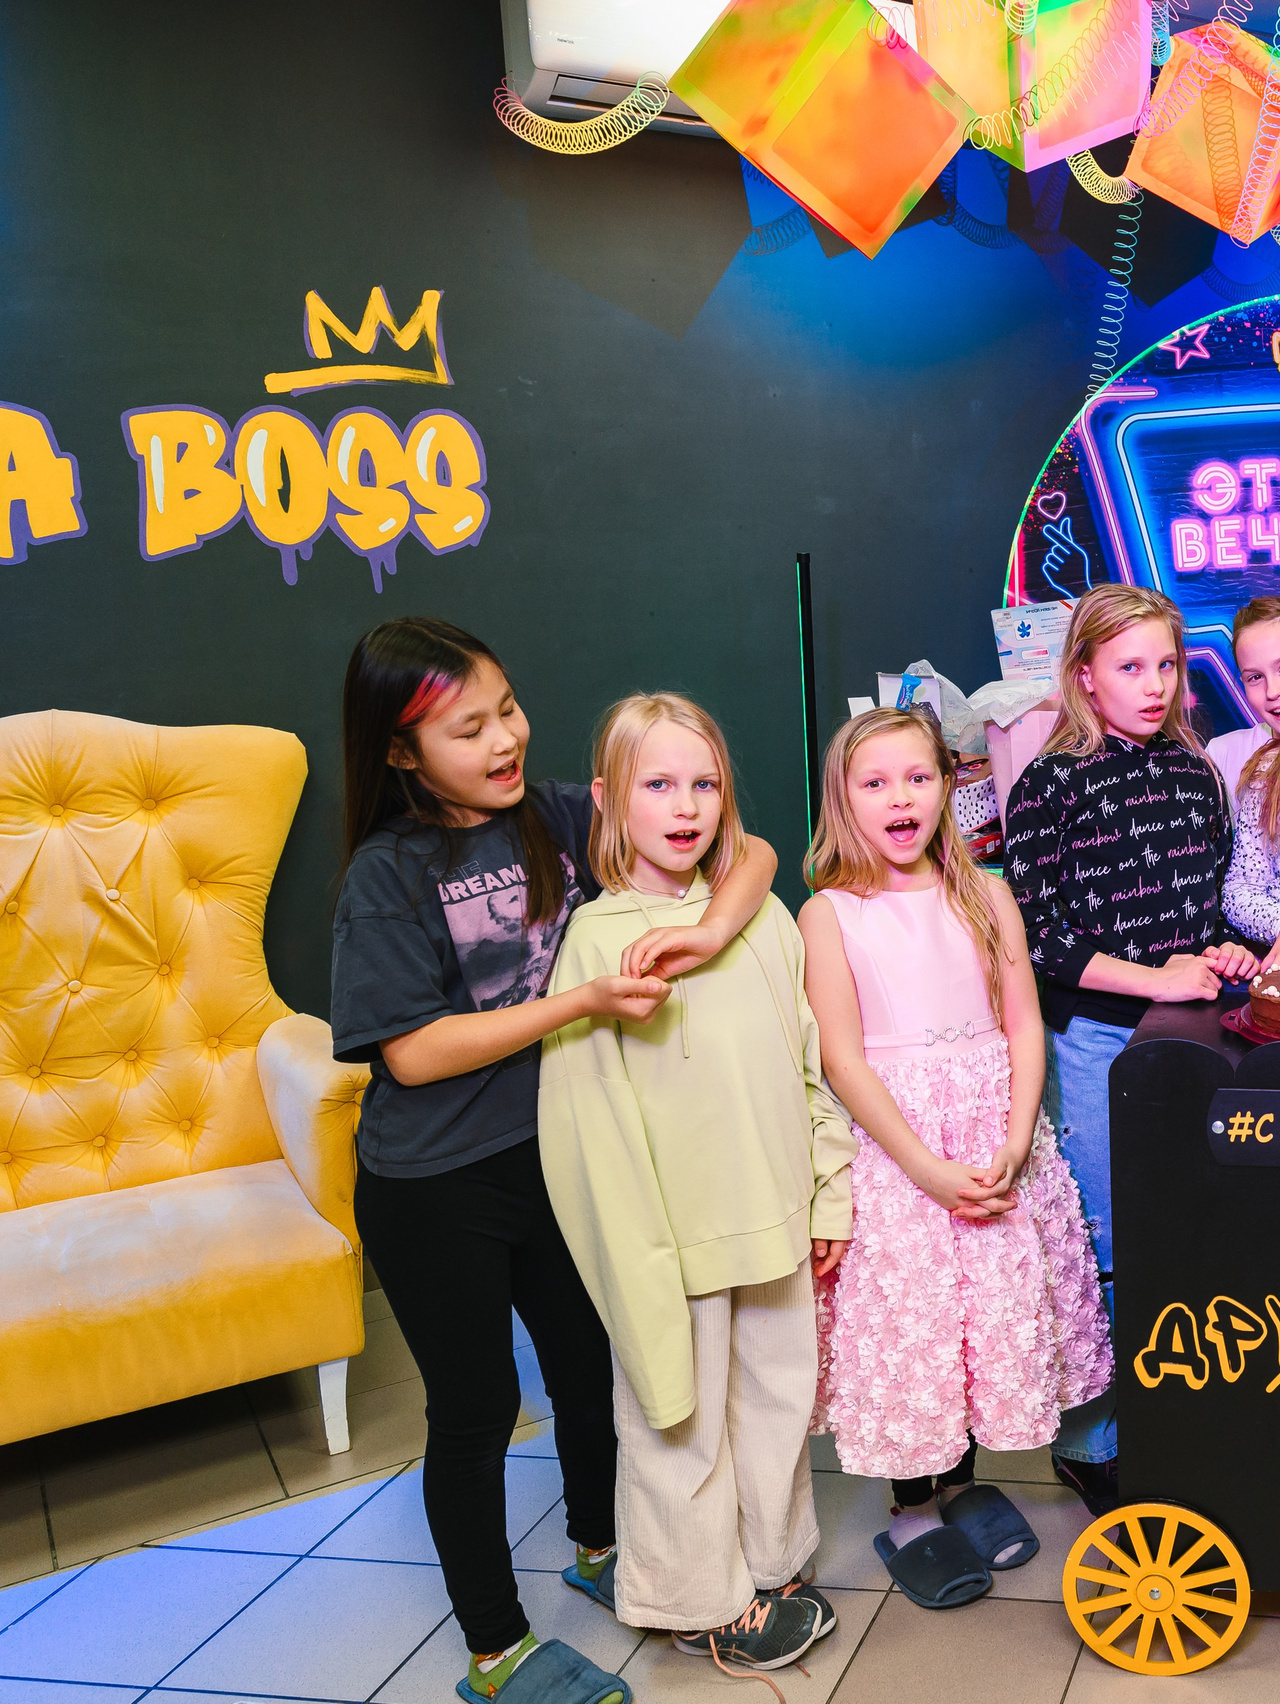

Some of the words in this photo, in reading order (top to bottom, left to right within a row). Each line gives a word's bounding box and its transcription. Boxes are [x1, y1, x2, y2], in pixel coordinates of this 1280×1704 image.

[121, 404, 491, 570] BOSS
[1084, 777, 1120, 805] dance
[1126, 768, 1143, 780] on
[1145, 757, 1163, 780] the
[1077, 810, 1095, 824] on
[1098, 794, 1119, 819] the
[1175, 784, 1204, 804] dance
[1129, 817, 1165, 840] dance
[1170, 817, 1186, 829] on
[1188, 807, 1206, 830] the
[437, 864, 530, 903] DREAM
[1010, 855, 1031, 880] the
[1074, 861, 1112, 885] dance
[1118, 857, 1139, 871] on
[1141, 843, 1161, 869] the
[1085, 887, 1105, 912] the
[1171, 869, 1203, 892] dance
[1113, 912, 1153, 936] dance
[1159, 909, 1179, 922] on
[1182, 895, 1199, 921] the
[1123, 939, 1142, 962] the
[1227, 1110, 1275, 1143] #С
